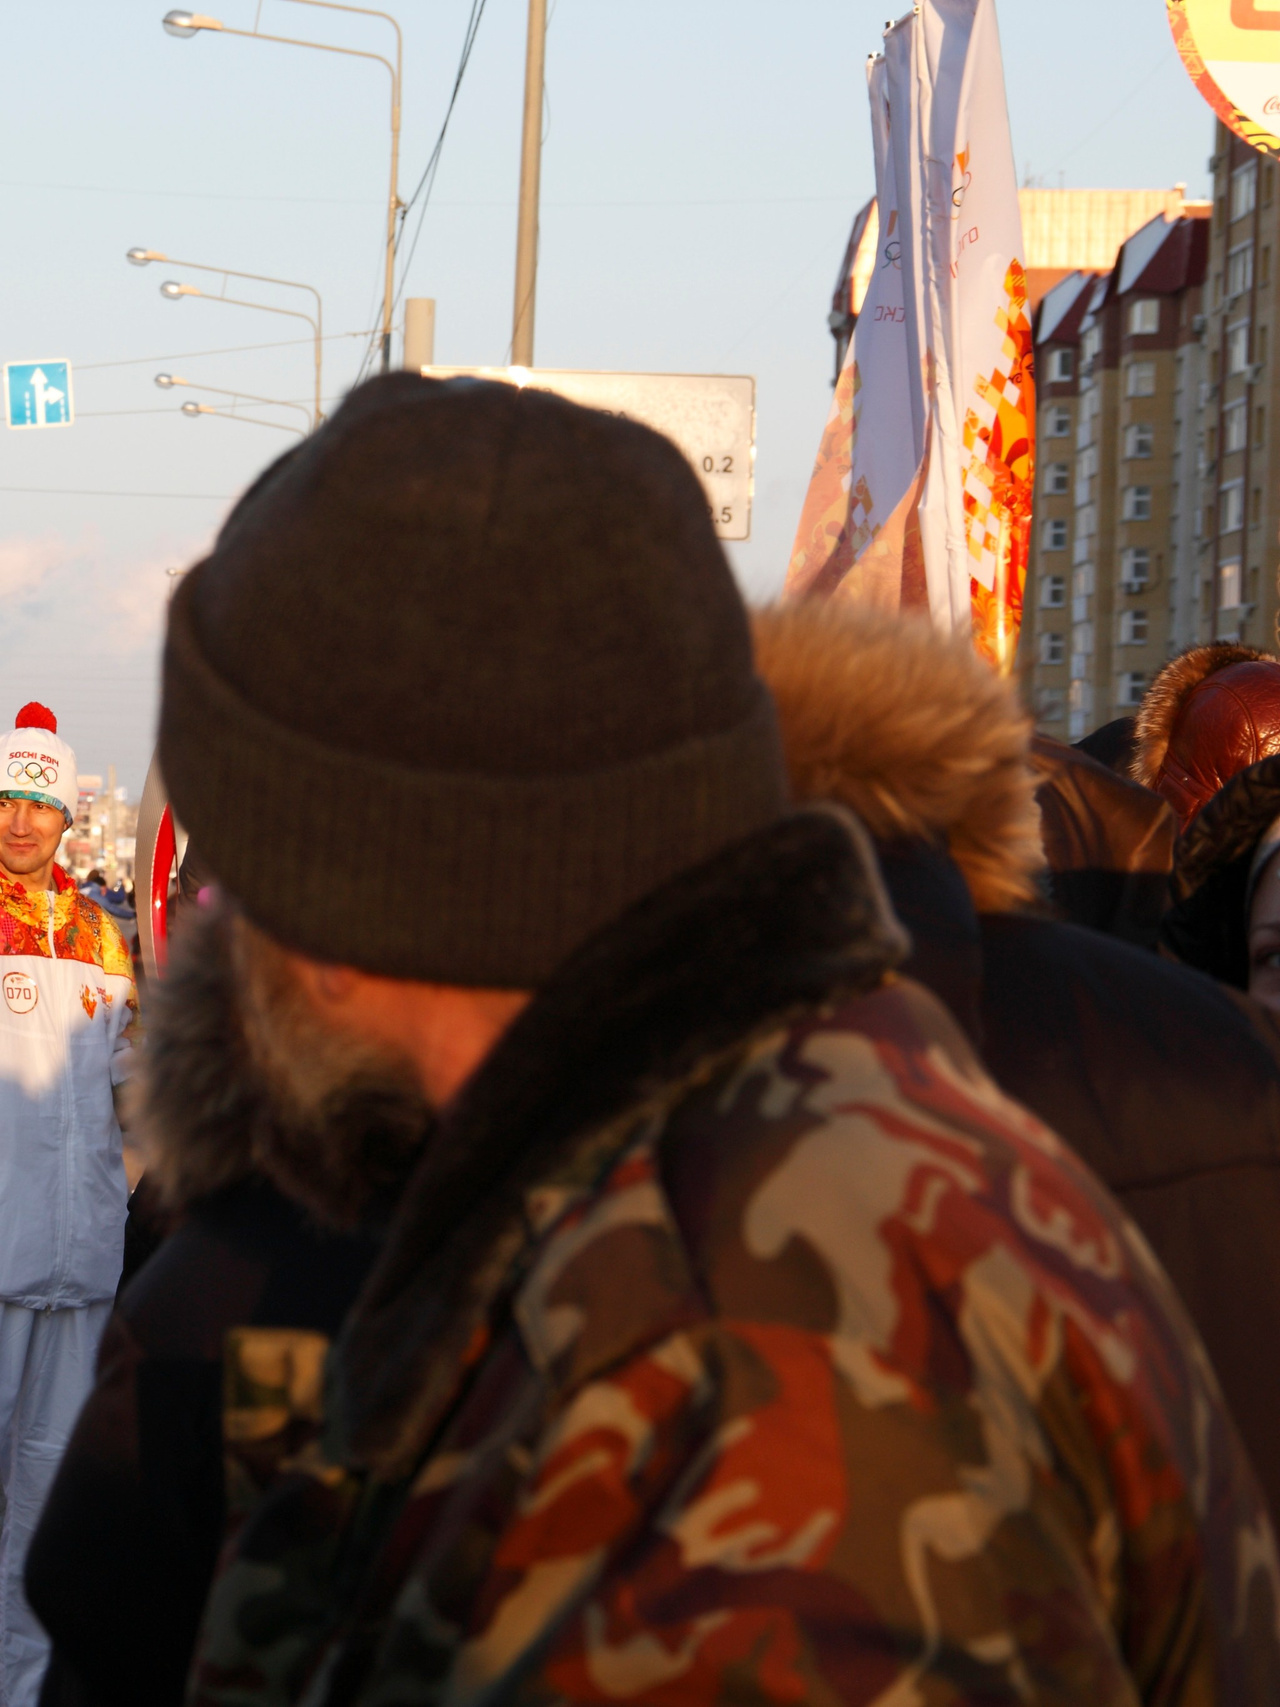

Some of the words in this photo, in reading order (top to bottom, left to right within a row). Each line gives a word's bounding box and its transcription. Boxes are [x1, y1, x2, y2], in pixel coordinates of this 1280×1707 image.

[703, 456, 733, 473] 0.2
[8, 751, 37, 759] SOCHI
[40, 754, 60, 767] 2014
[6, 987, 32, 1000] 070
